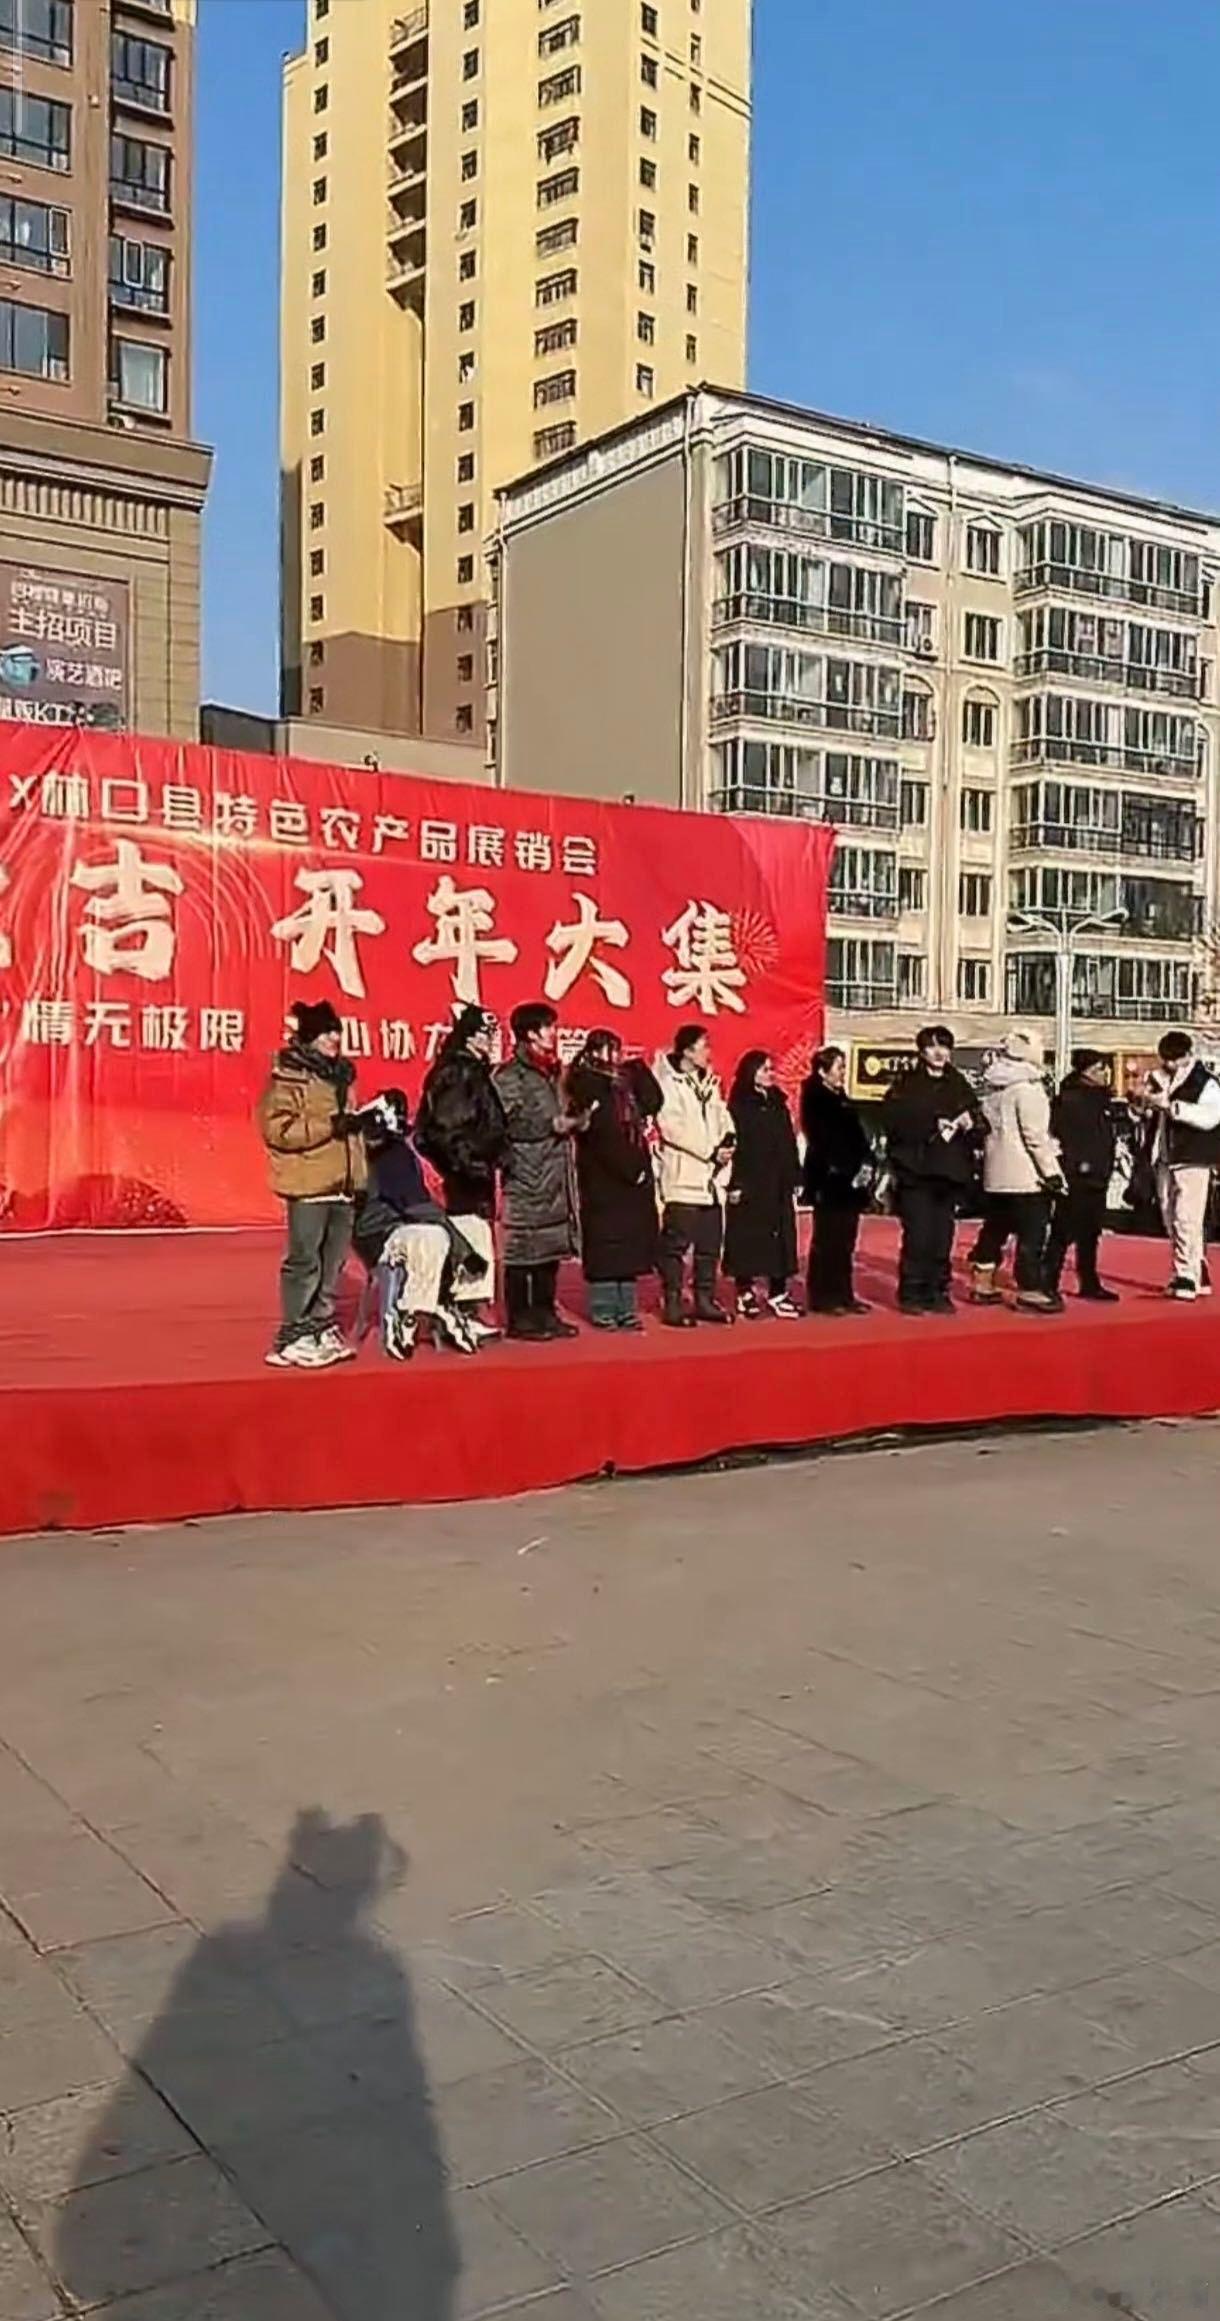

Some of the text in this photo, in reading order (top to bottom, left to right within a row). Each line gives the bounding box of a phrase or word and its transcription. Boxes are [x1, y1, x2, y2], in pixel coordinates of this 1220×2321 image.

[8, 607, 117, 649] 主招项目
[1, 998, 245, 1053] 情无极限
